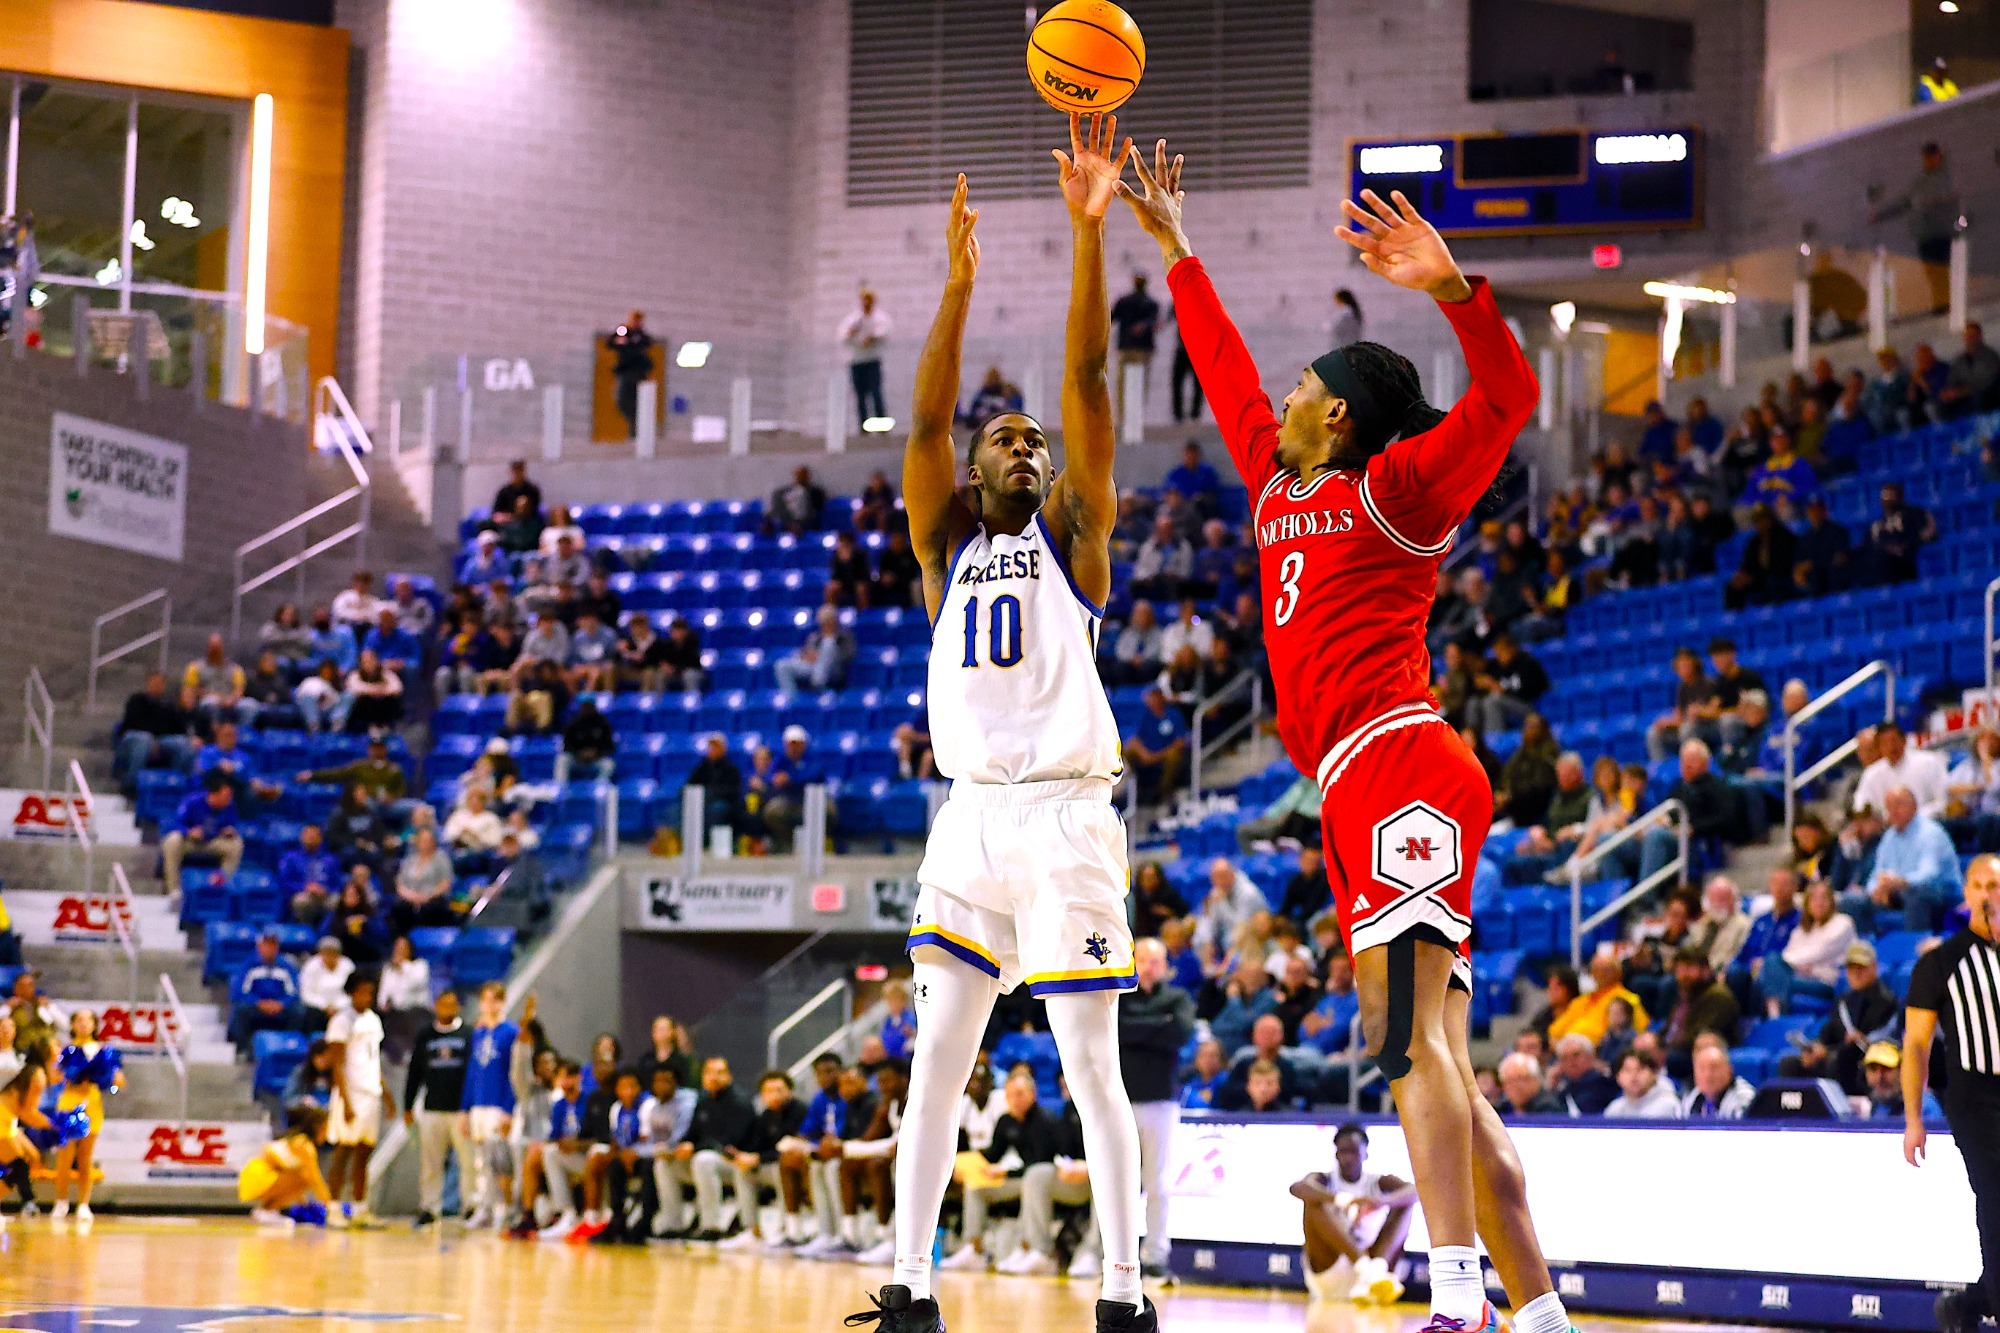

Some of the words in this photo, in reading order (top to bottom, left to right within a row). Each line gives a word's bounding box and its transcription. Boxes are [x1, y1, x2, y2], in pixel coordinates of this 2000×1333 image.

[1044, 70, 1100, 102] NCAA
[484, 358, 535, 391] GA
[98, 438, 157, 471] CONTROL
[66, 453, 113, 484] YOUR
[117, 468, 177, 500] HEALTH
[1259, 508, 1354, 550] NICHOLLS
[1274, 550, 1305, 628] 3
[961, 594, 1025, 669] 10
[1405, 836, 1432, 860] N
[143, 1125, 228, 1165] ACE
